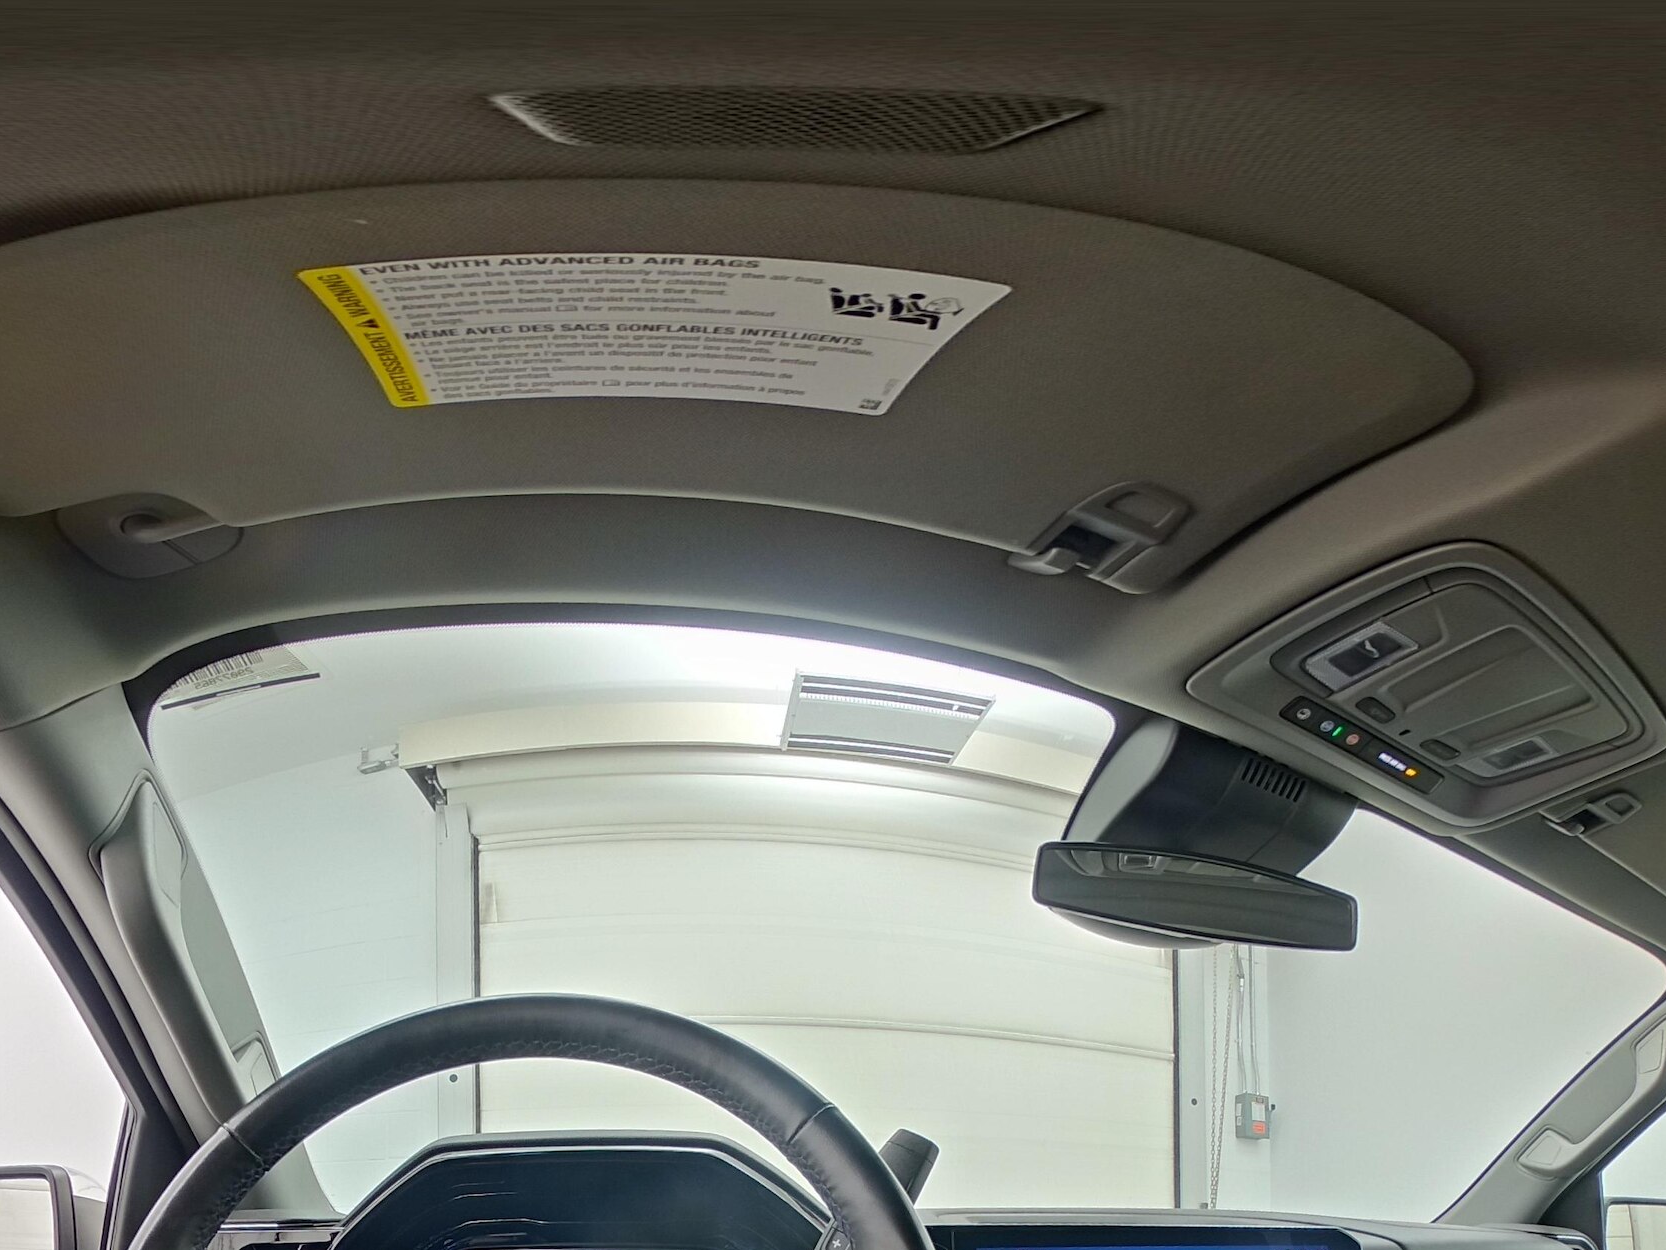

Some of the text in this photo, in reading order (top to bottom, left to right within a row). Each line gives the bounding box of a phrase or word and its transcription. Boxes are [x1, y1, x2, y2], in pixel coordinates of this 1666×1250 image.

[359, 264, 420, 275] EVEN
[428, 259, 489, 269] WITH
[499, 257, 634, 266] ADVANCED
[693, 258, 760, 268] BAGS
[317, 273, 419, 402] AVERTISSEMENT WARNING
[405, 323, 863, 346] MÊME AVEC DES SACS GONFLABLES INTELLIGENTS
